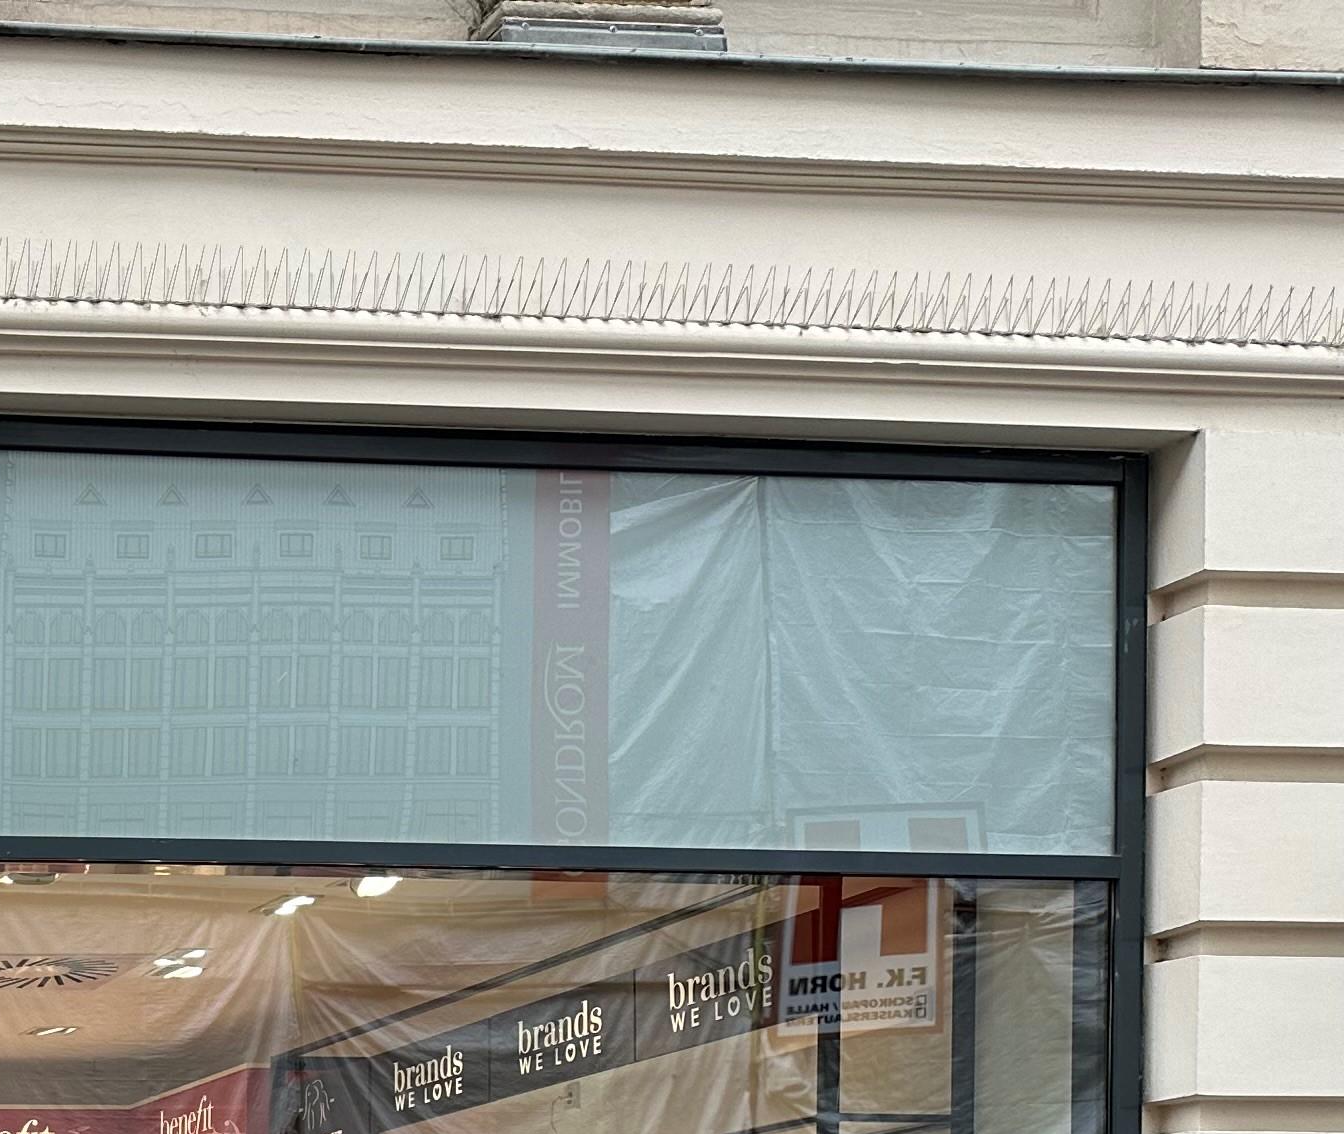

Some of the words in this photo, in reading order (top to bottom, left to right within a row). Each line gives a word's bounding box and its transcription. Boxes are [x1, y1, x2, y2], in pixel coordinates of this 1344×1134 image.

[667, 947, 774, 1011] brands
[517, 1000, 603, 1055] brands
[670, 1006, 701, 1033] WE
[714, 986, 773, 1022] LOVE
[393, 1045, 464, 1094] brands
[519, 1054, 544, 1076] WE
[555, 1035, 602, 1066] LOVE
[395, 1091, 416, 1112] WE
[424, 1076, 463, 1104] LOVE
